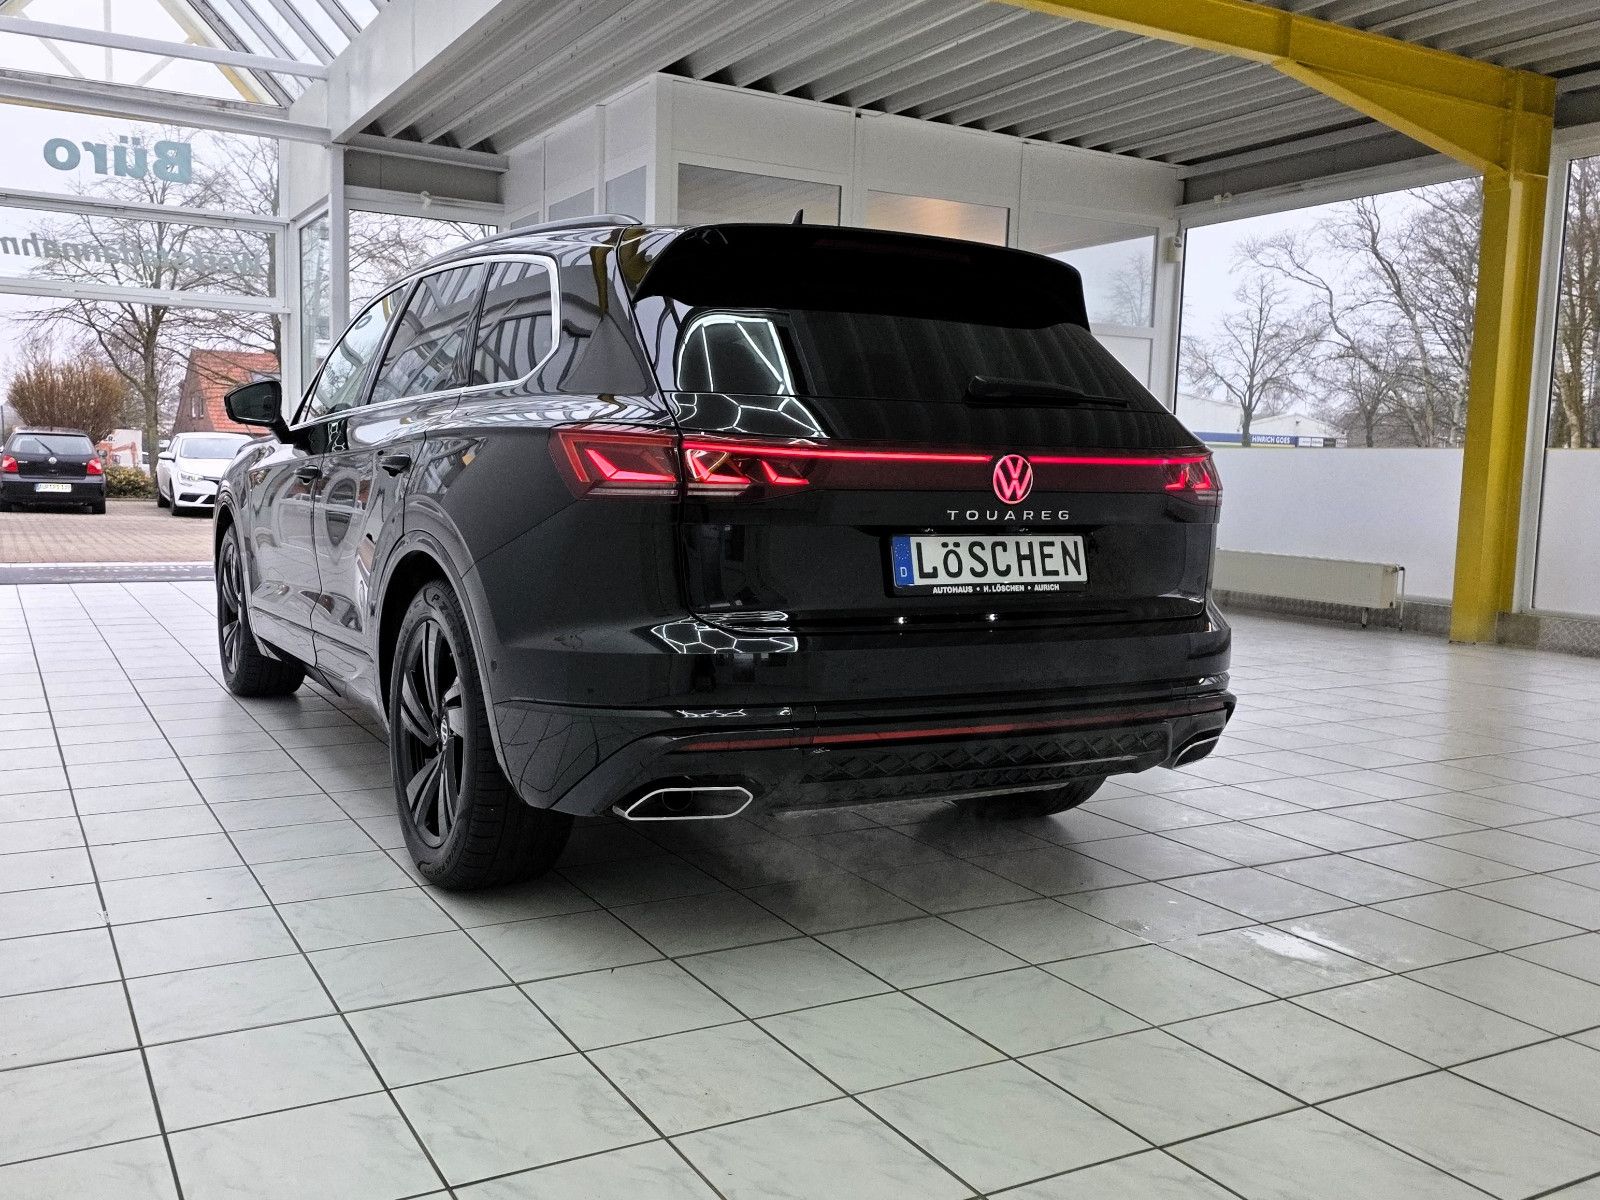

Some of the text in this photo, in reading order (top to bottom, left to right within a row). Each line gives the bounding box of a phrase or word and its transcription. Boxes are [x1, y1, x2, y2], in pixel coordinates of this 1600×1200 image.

[993, 454, 1033, 504] VW
[947, 509, 1070, 521] TOUAREG
[900, 566, 908, 578] D
[932, 586, 973, 594] AUTOHAUS
